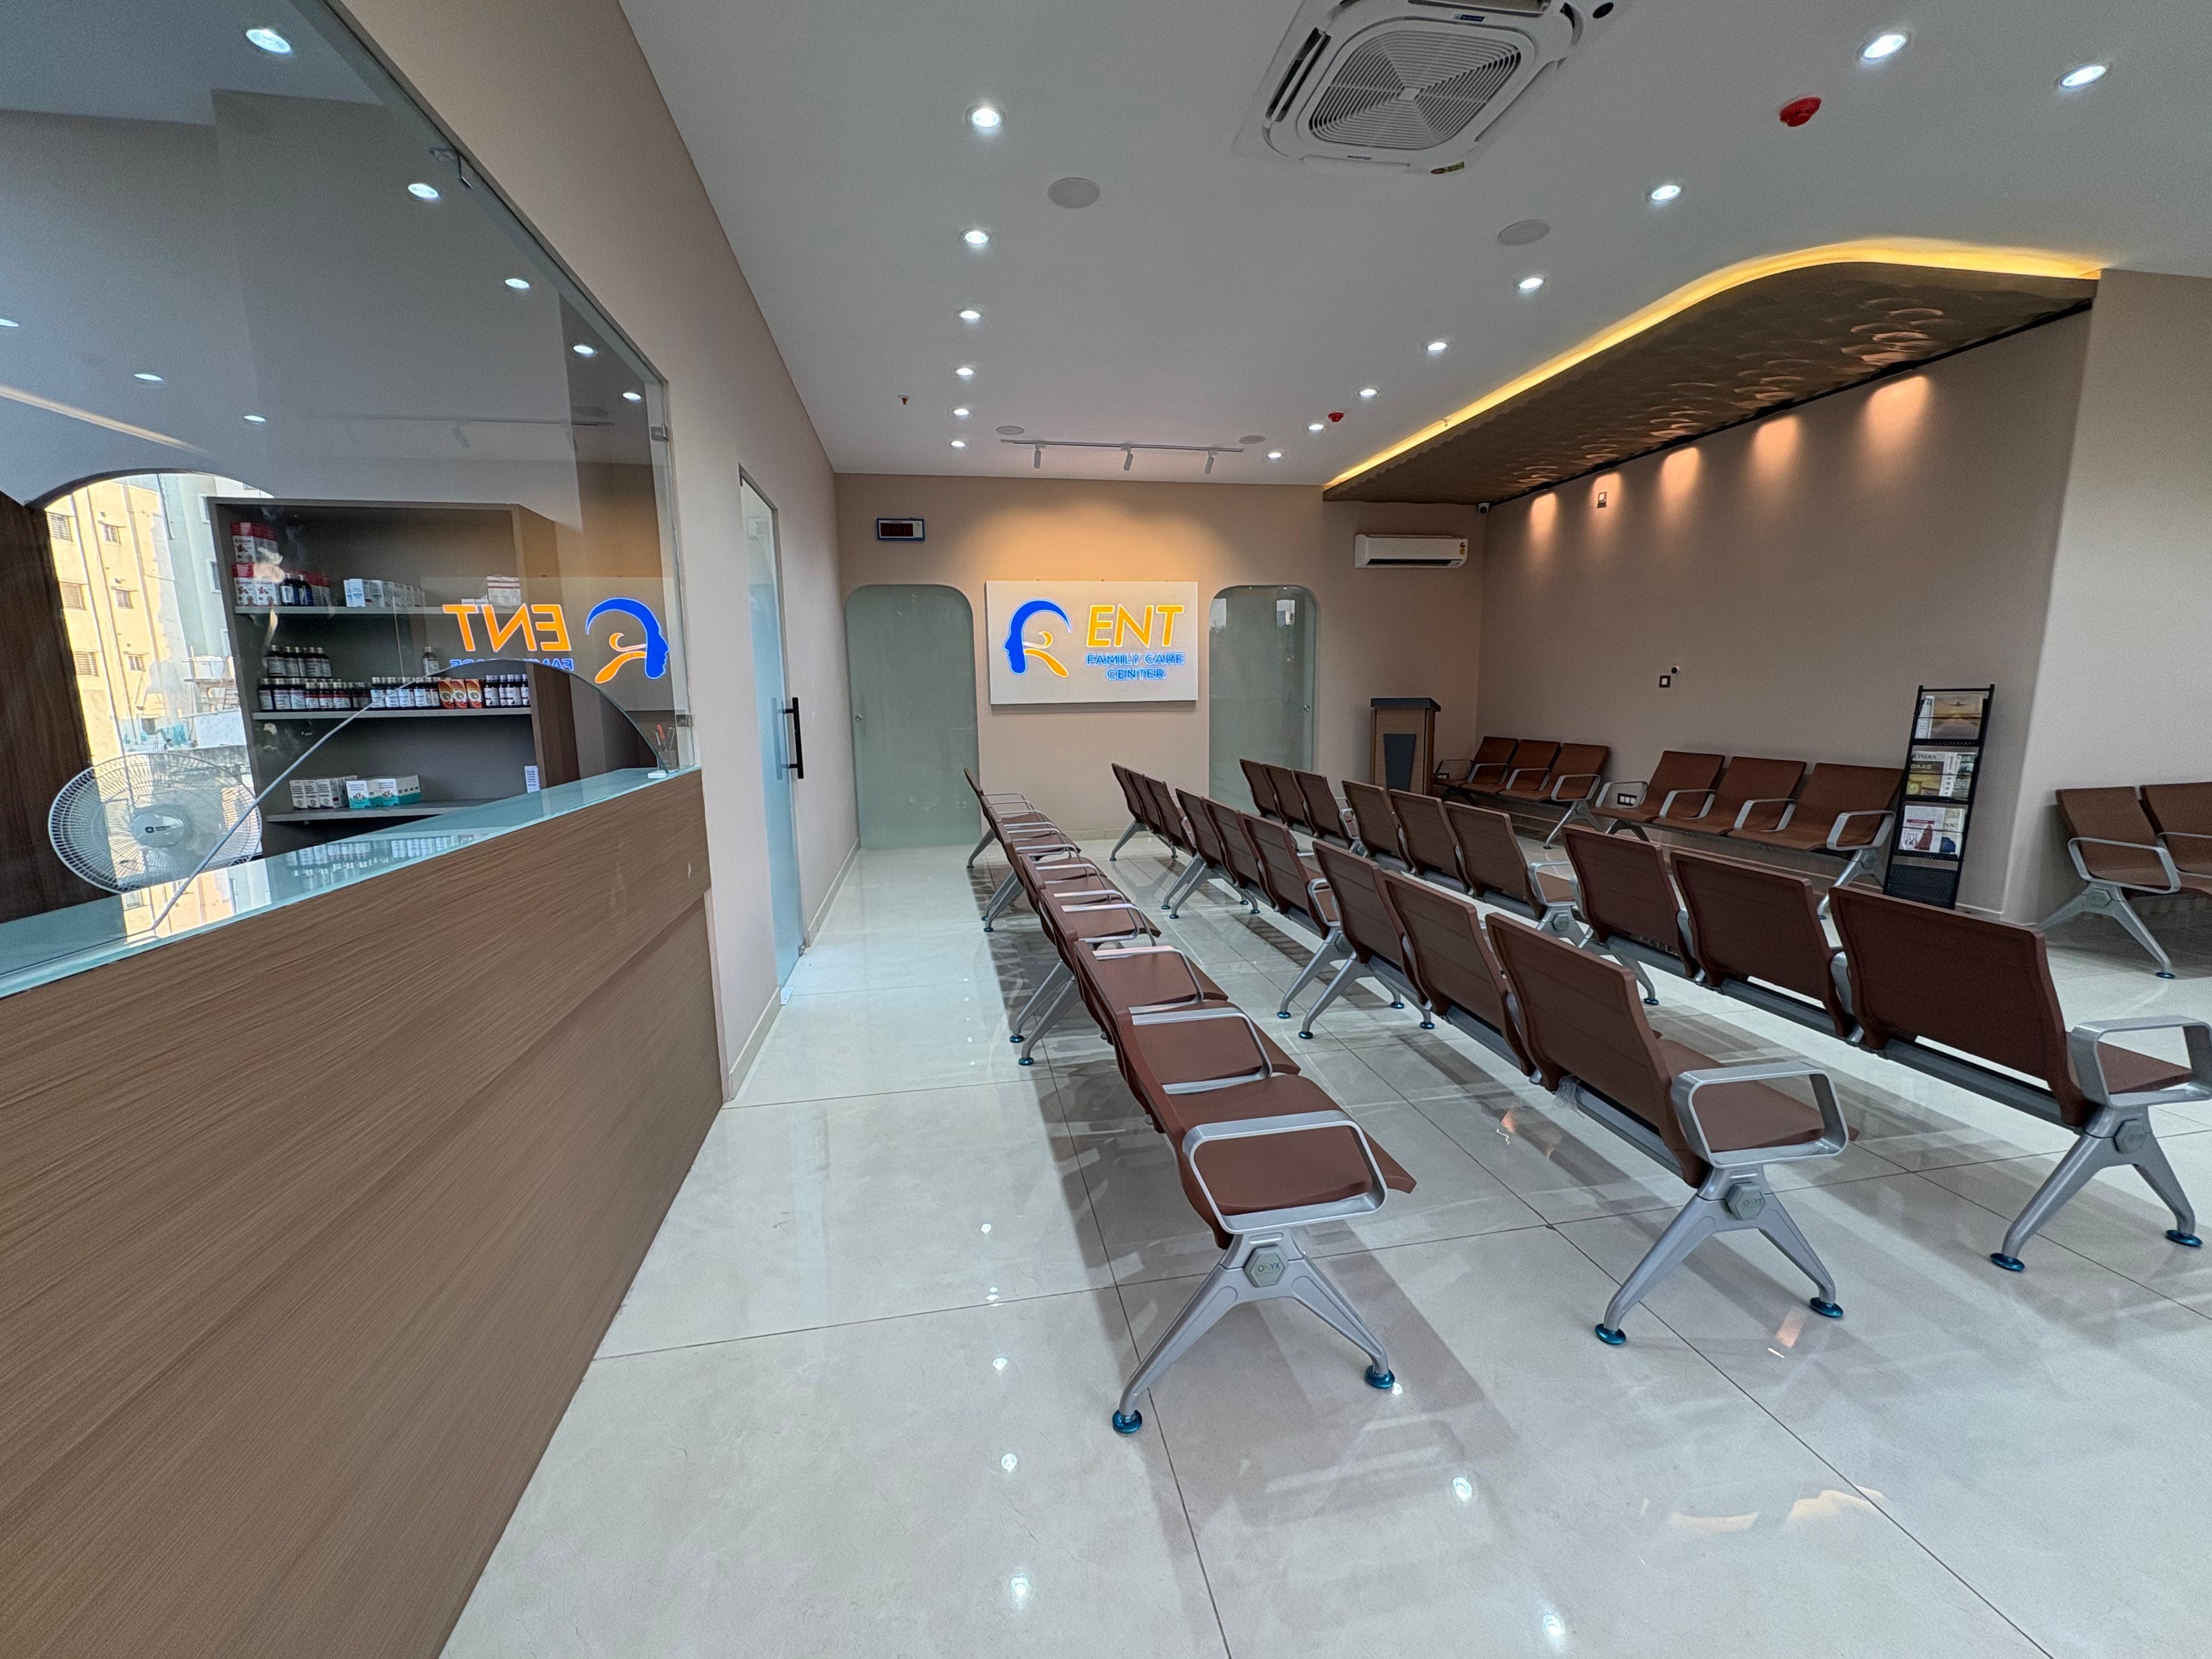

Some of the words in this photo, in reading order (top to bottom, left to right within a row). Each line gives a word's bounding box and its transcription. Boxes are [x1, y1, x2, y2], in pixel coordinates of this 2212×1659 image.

[1086, 603, 1185, 648] ENT
[1086, 653, 1141, 666] FAMILY
[1143, 653, 1184, 665] CARE
[1105, 668, 1166, 680] CENTER
